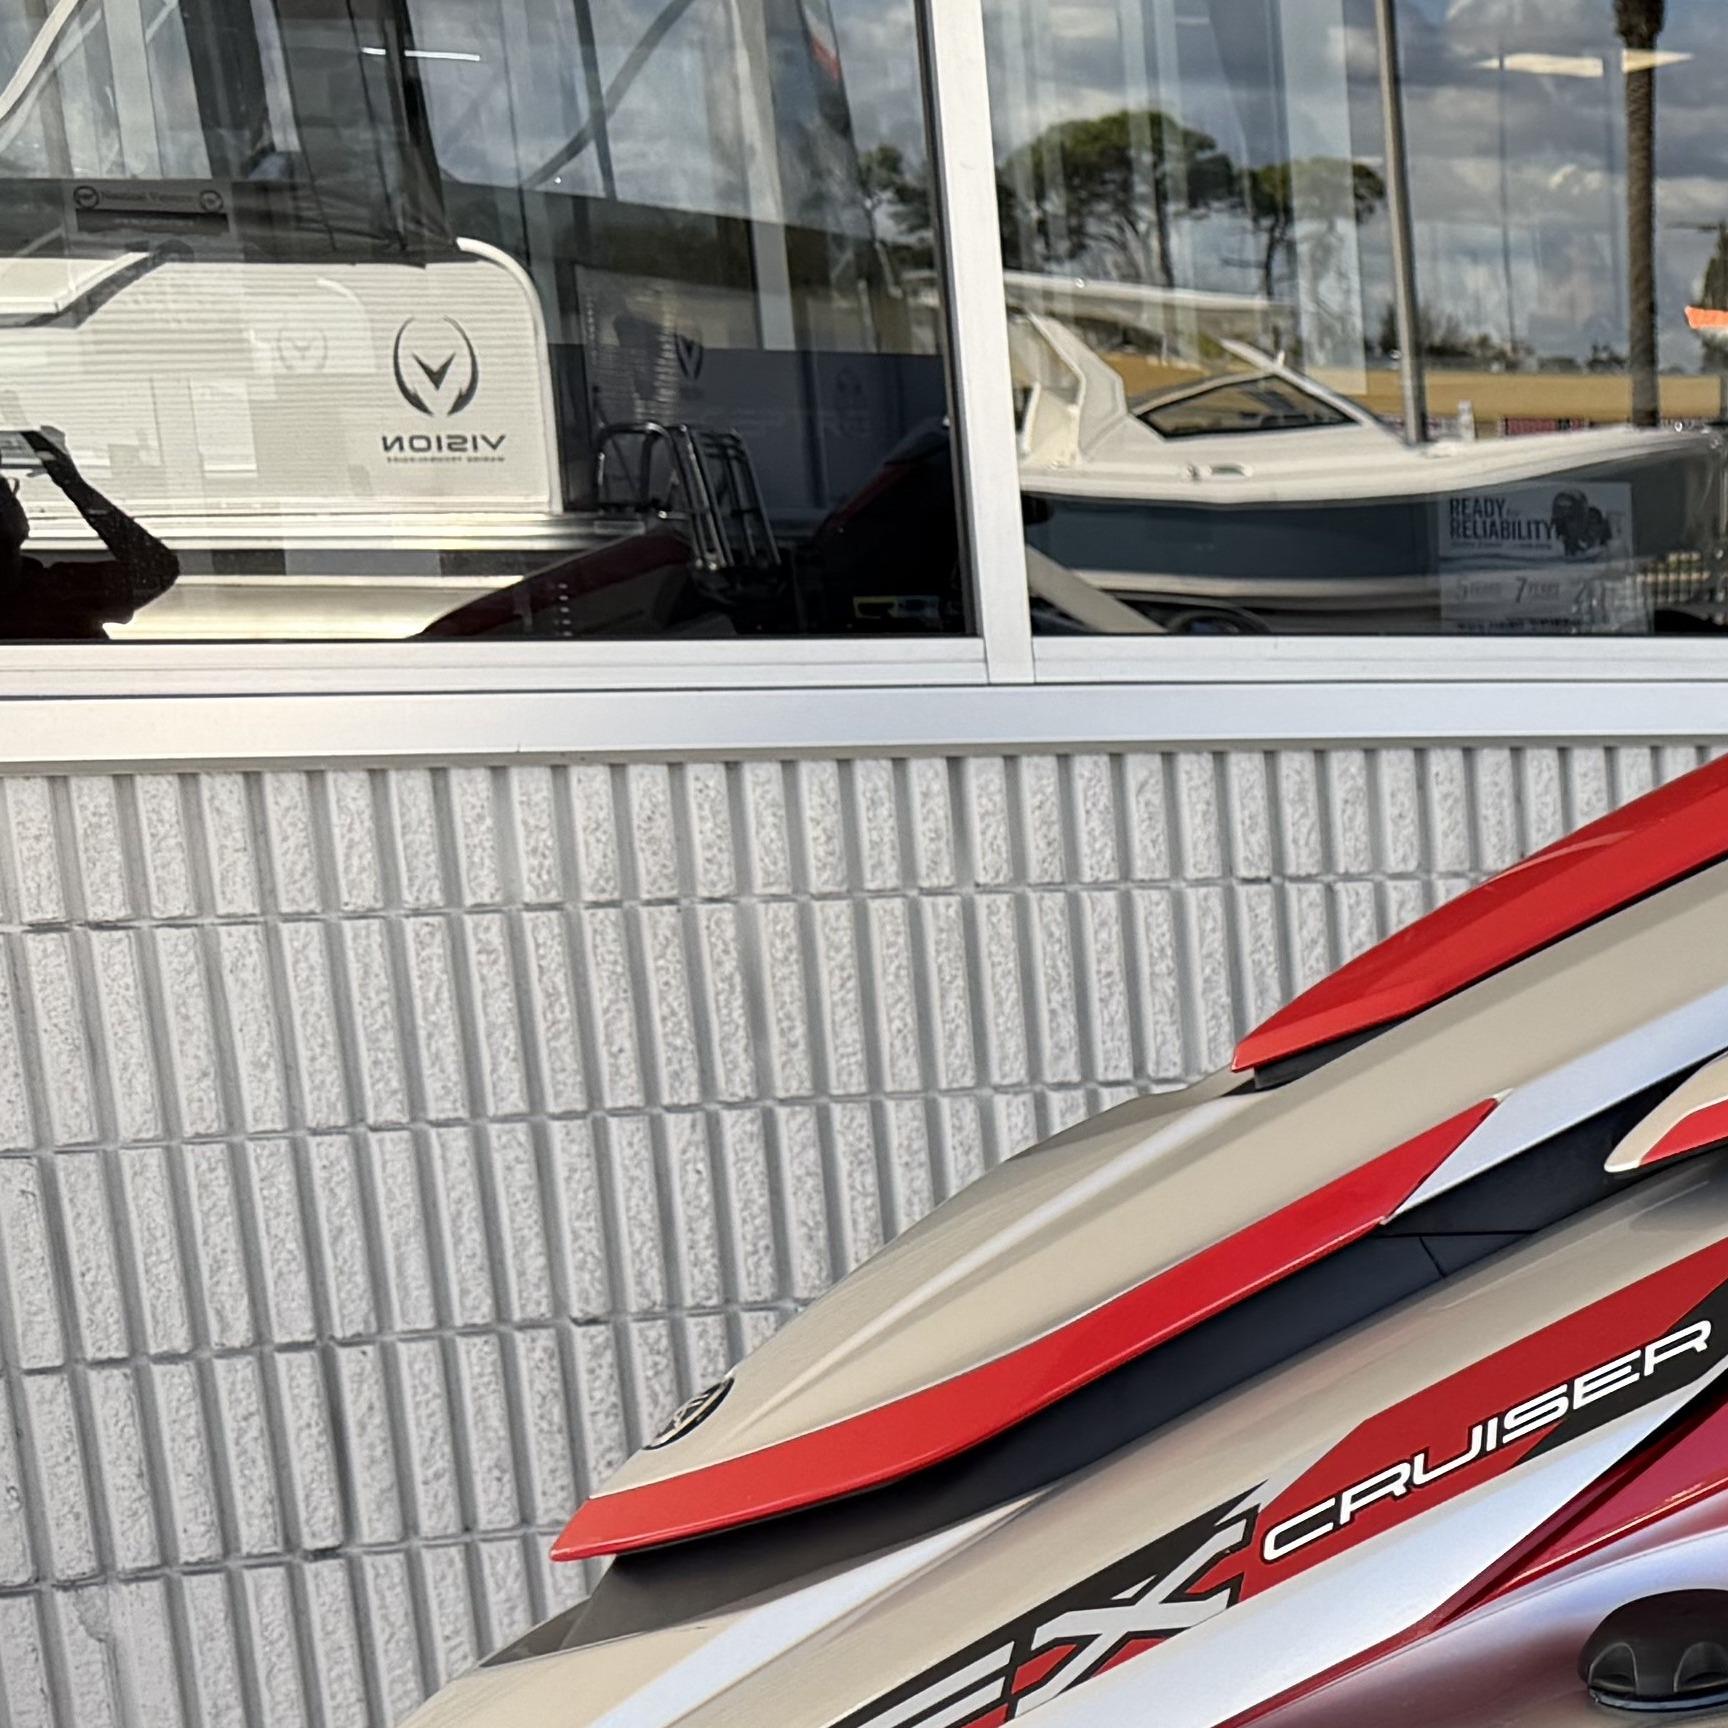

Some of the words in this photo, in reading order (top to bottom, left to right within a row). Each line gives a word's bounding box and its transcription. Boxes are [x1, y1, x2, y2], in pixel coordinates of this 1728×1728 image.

[1450, 497, 1507, 519] READY
[1450, 519, 1554, 541] RELIABILITY
[1261, 1319, 1713, 1562] CRUISER
